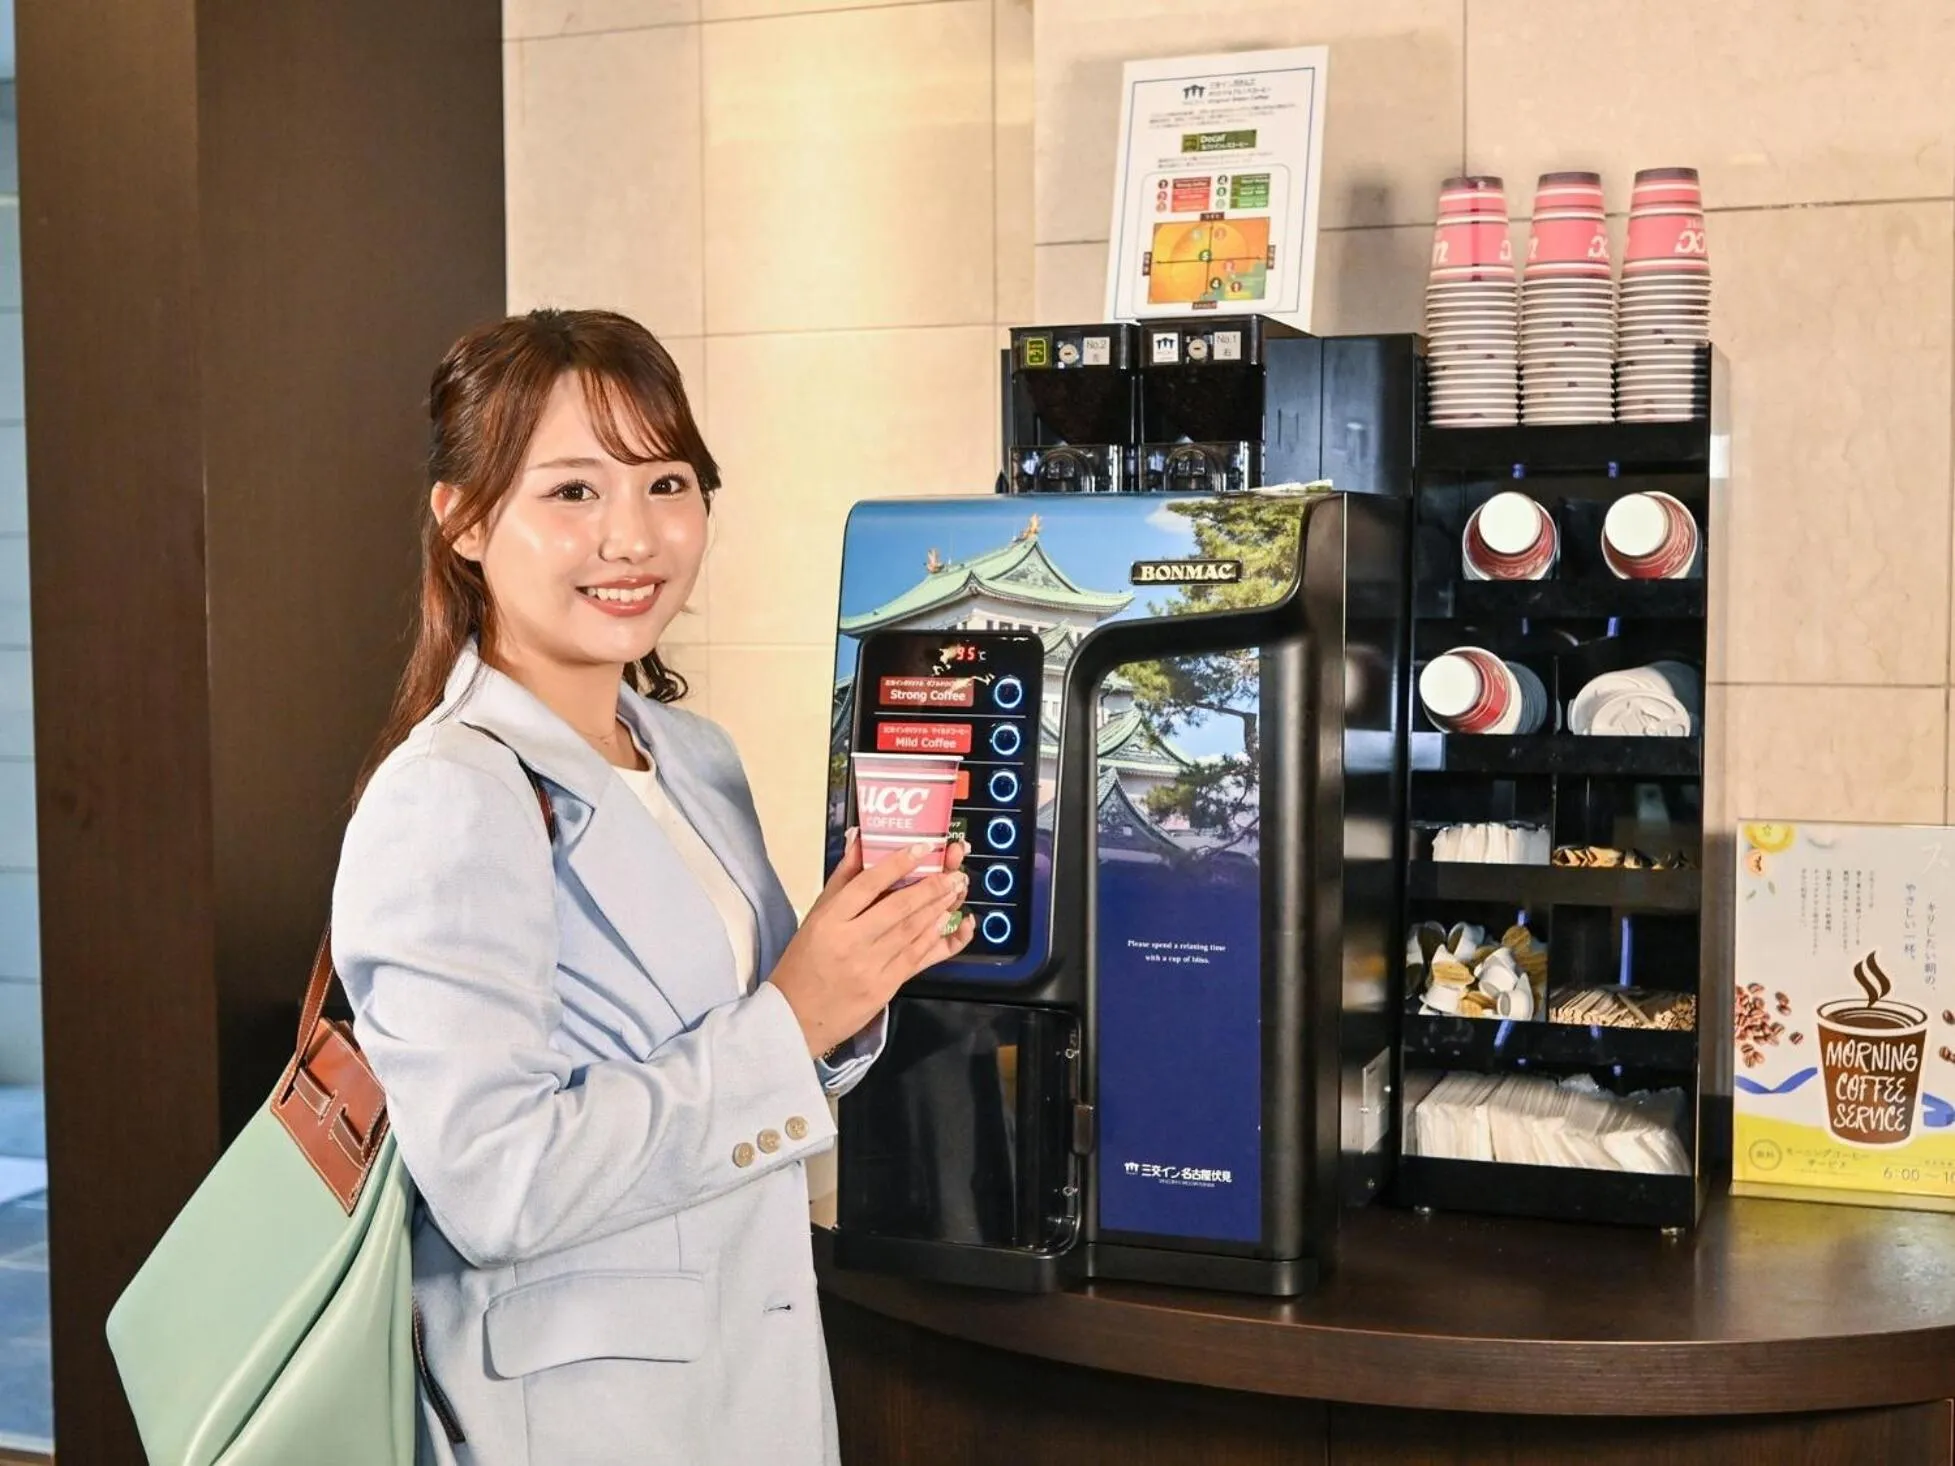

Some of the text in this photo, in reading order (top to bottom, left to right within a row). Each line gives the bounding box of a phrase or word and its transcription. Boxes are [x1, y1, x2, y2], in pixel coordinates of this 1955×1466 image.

[1200, 133, 1227, 143] Decaf
[1141, 563, 1234, 581] BONMAC
[956, 646, 975, 661] 95
[890, 689, 966, 702] Strong Coffee
[895, 736, 957, 749] Mild Coffee
[866, 816, 914, 829] COFFEE
[1127, 939, 1150, 948] Please
[1152, 941, 1172, 950] spend
[1180, 942, 1208, 952] relaxing
[1145, 954, 1160, 962] with
[1168, 956, 1181, 964] cup
[1826, 1039, 1918, 1072] MORNING
[1836, 1071, 1906, 1103] COFFEE
[1834, 1103, 1906, 1133] SERVICE
